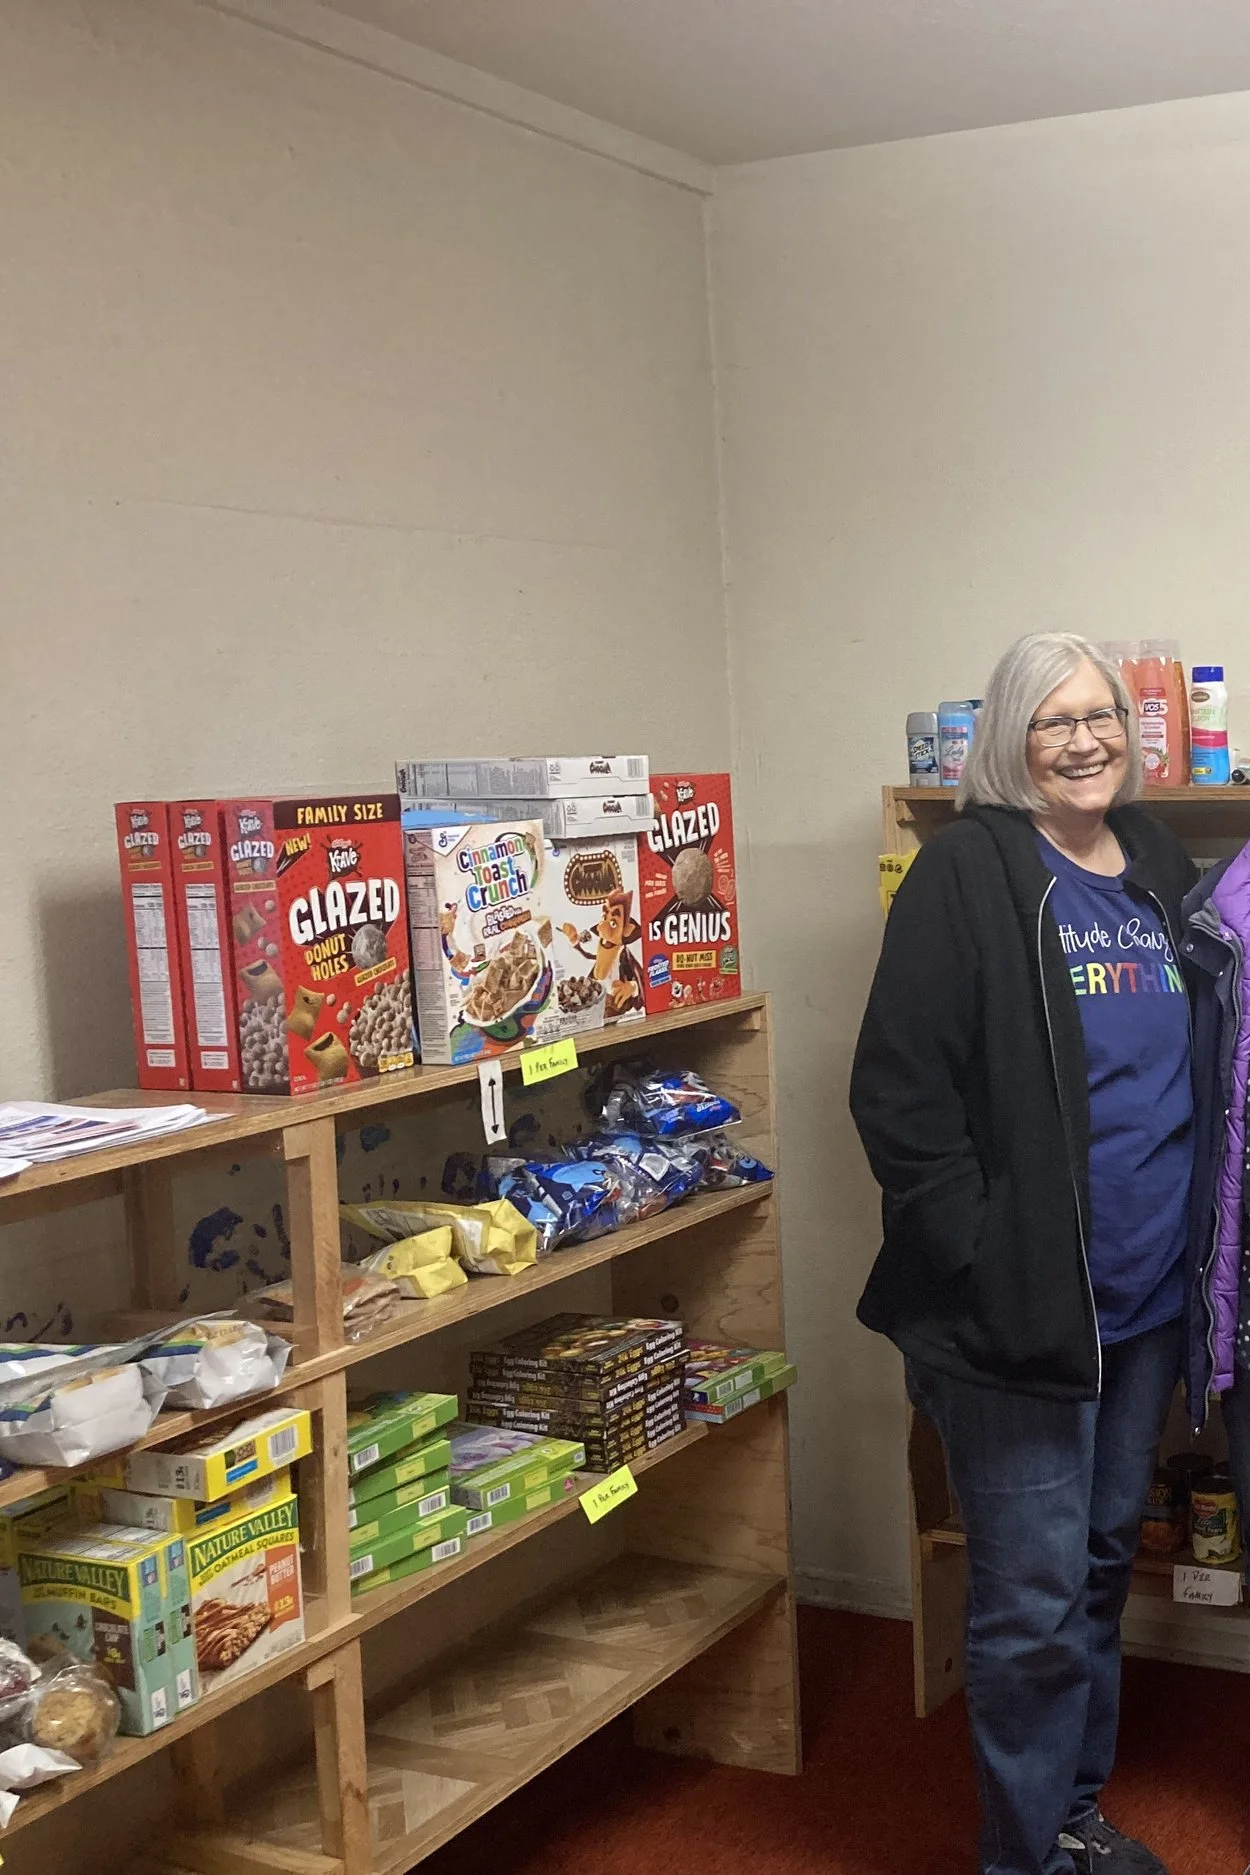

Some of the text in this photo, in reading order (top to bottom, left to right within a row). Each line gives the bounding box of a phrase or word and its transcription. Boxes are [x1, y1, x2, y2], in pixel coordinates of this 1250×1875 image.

[297, 803, 383, 824] FAMILY SIZE
[647, 802, 720, 853] GLAZED
[124, 832, 159, 849] GLAZED
[178, 832, 212, 850] GLAZED
[230, 840, 275, 862] GLAZED
[285, 832, 312, 856] NEW!
[459, 838, 523, 869] Cinnamon
[474, 857, 515, 885] Toast
[468, 869, 527, 910] Crunch
[289, 878, 400, 945] GLAZED
[649, 911, 731, 945] IS GENIUS
[305, 933, 346, 966] DONUT
[311, 954, 349, 981] HOLES
[529, 1064, 533, 1075] 1
[193, 1502, 294, 1574] NATURE VALLEY
[214, 1532, 295, 1573] OATMEAL SQUARES
[76, 1564, 125, 1599] VALLEY
